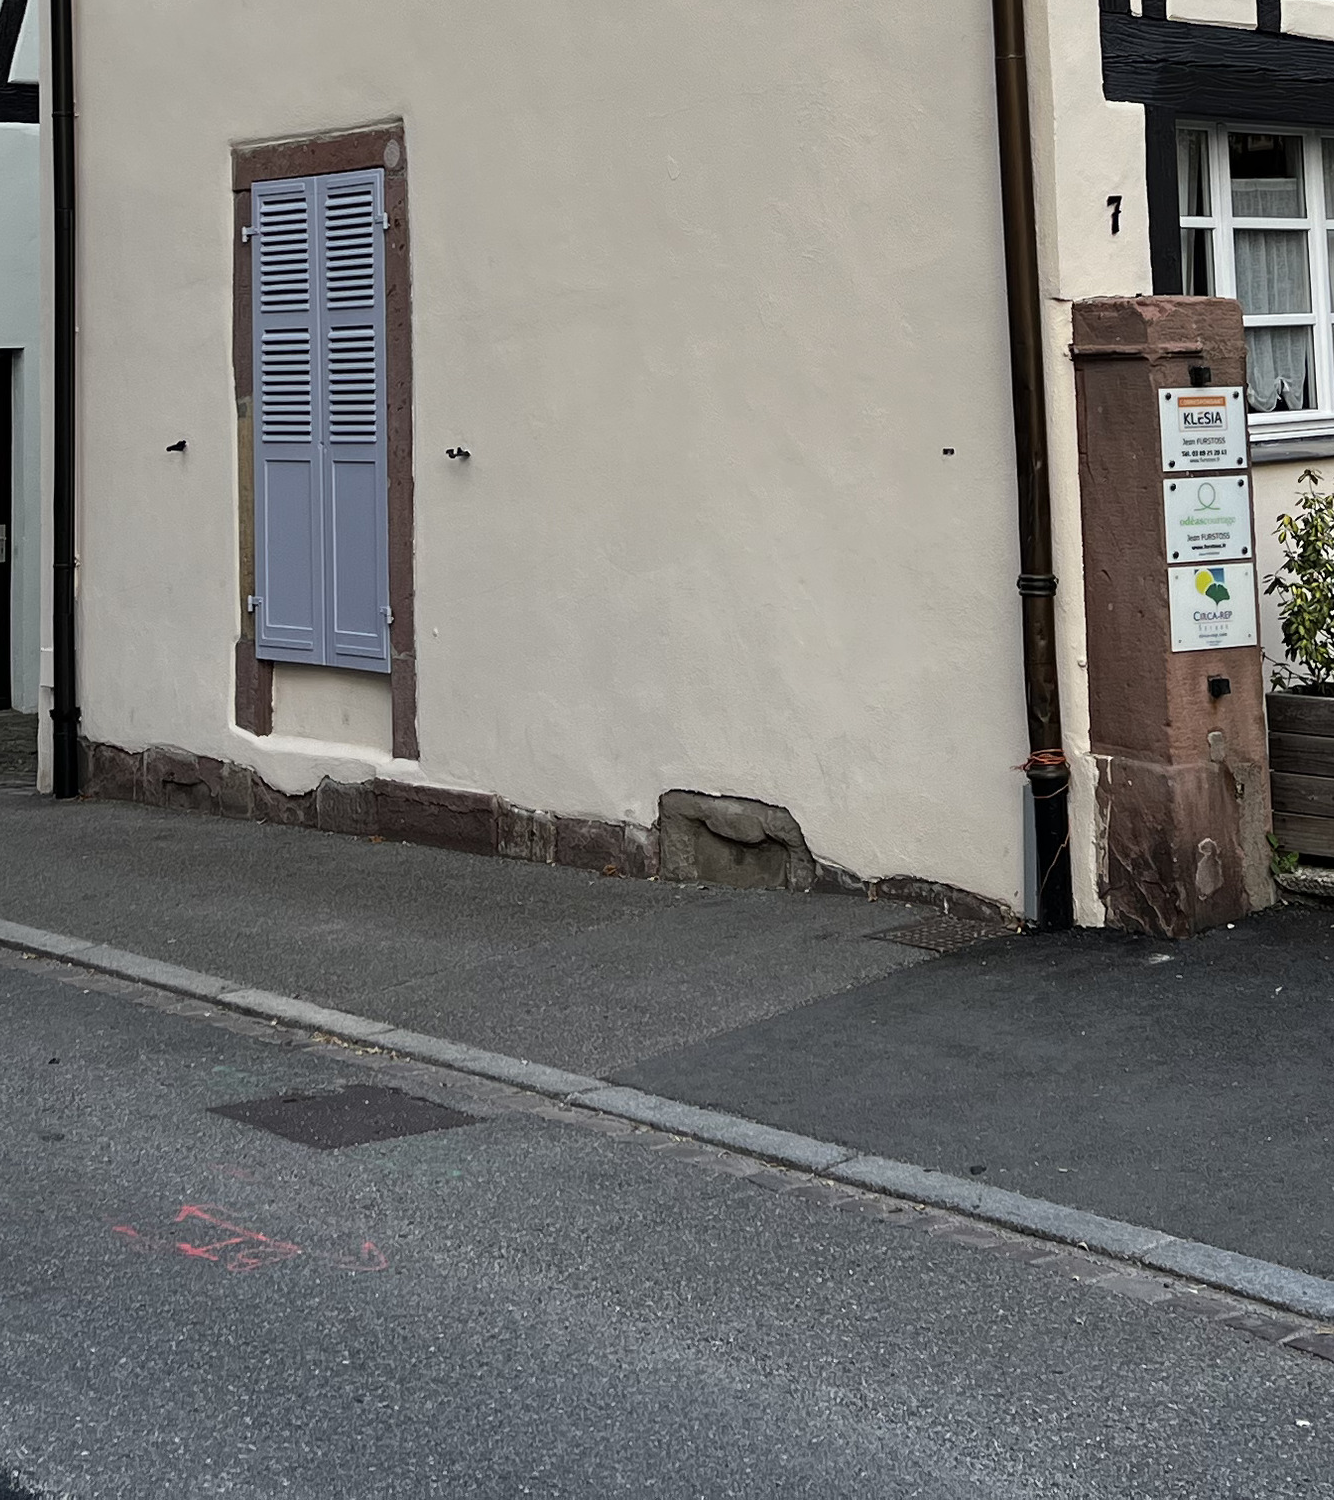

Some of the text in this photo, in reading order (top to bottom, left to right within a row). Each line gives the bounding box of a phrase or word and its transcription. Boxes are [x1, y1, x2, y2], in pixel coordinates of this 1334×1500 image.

[1106, 195, 1123, 235] 7
[1187, 532, 1230, 542] Jean FURSTOSS
